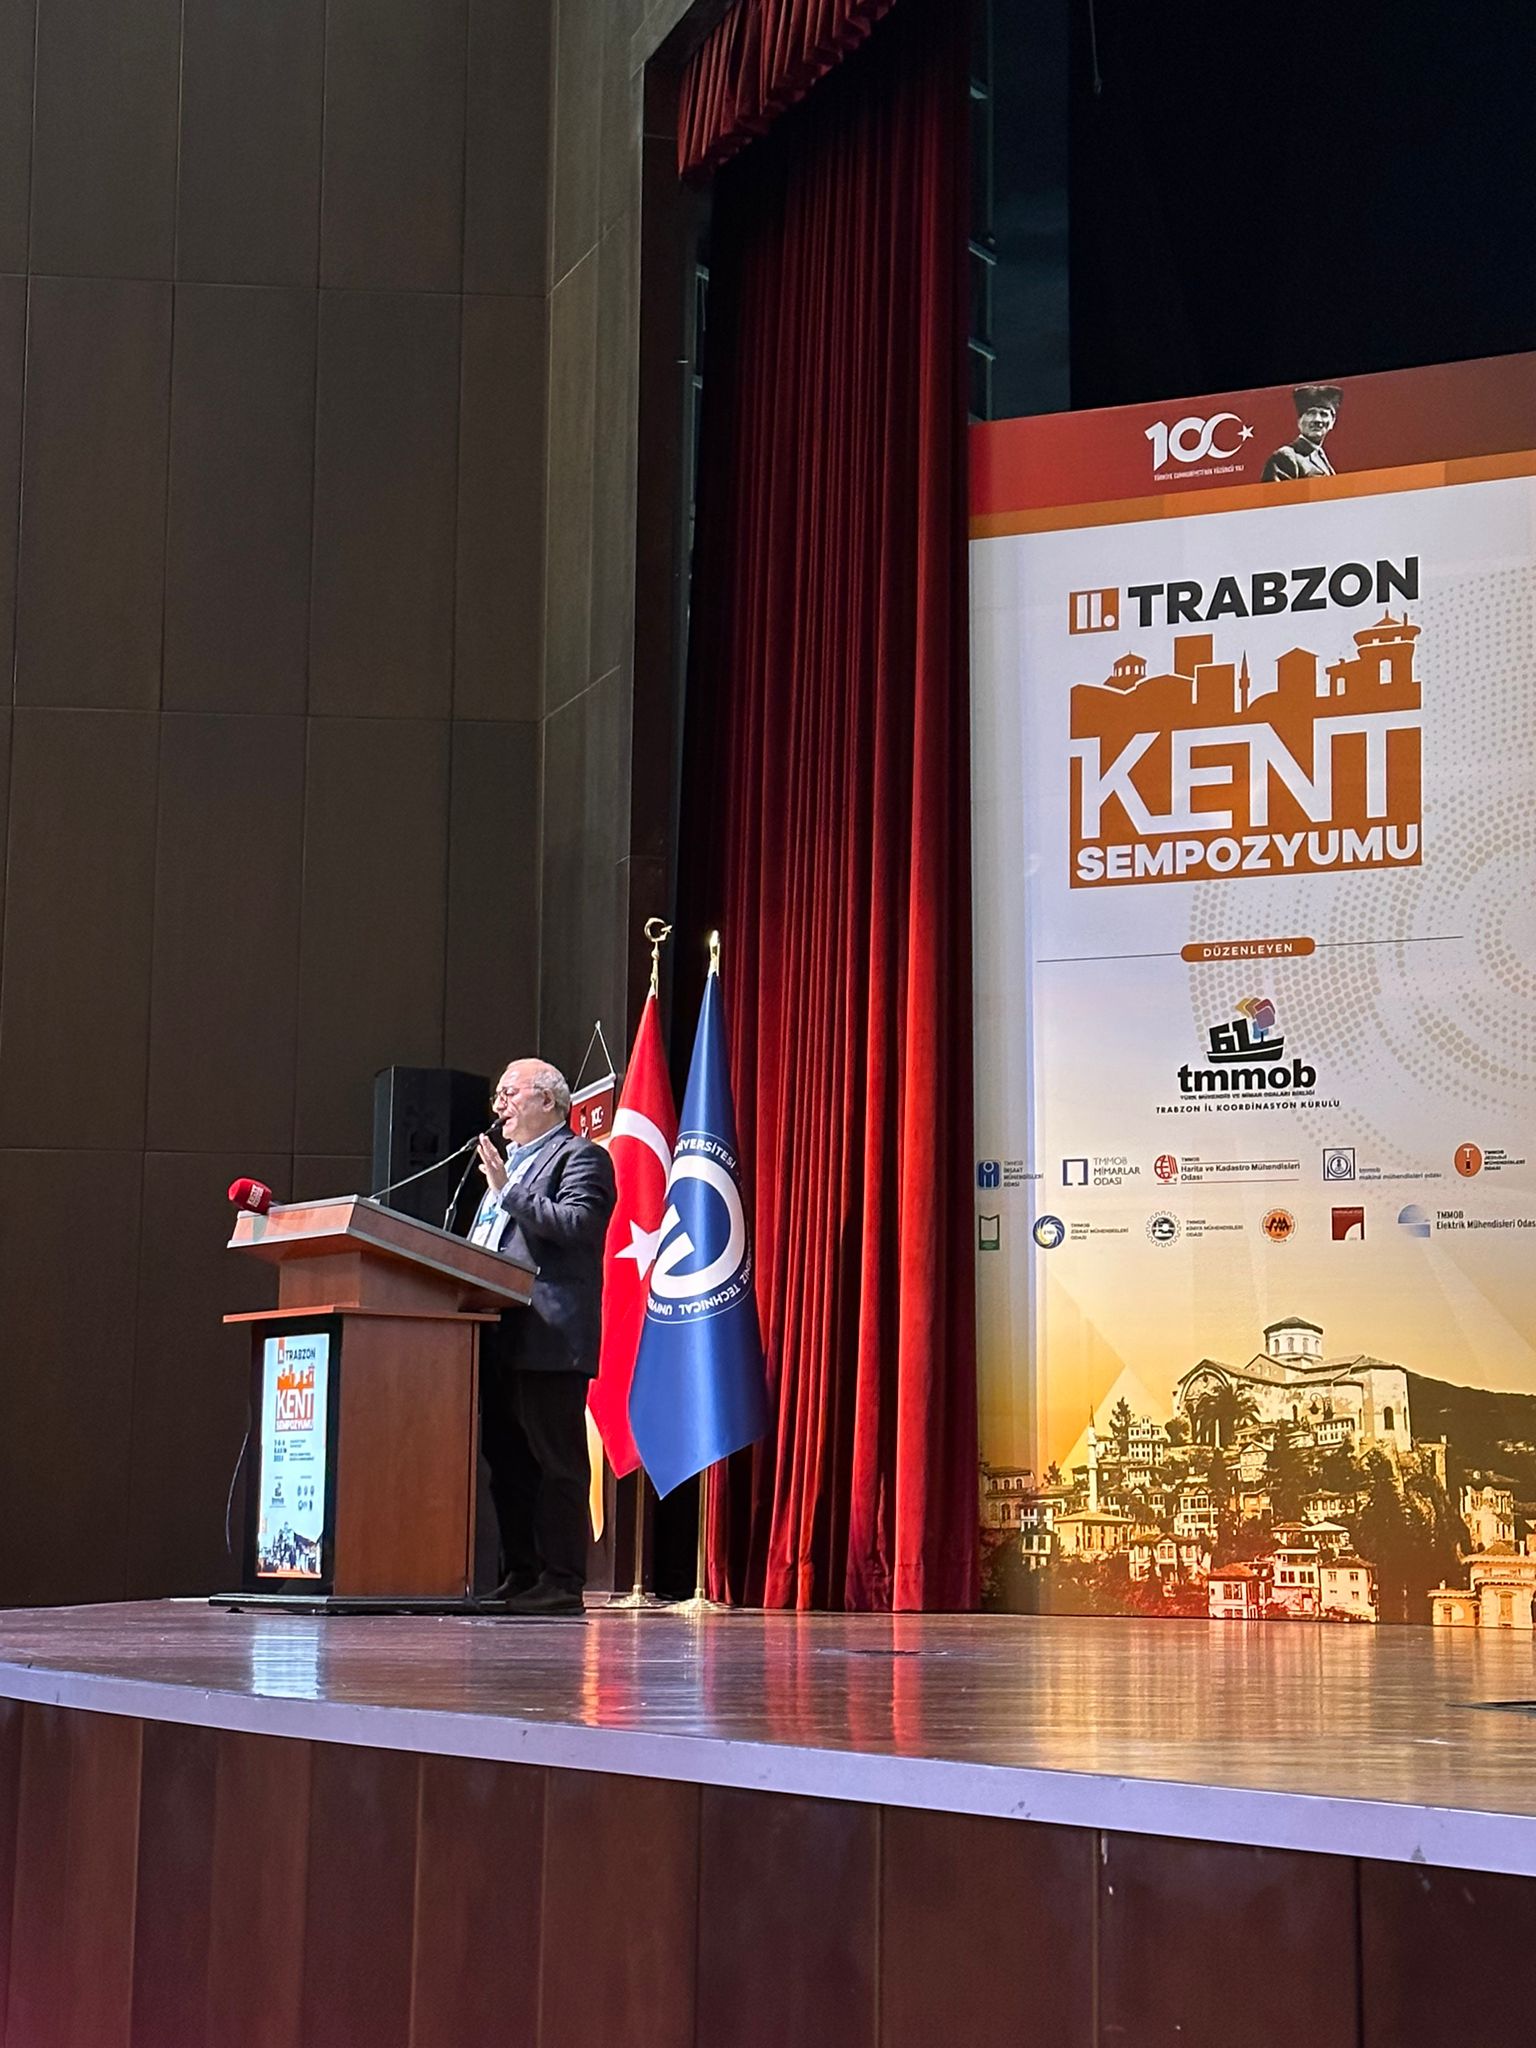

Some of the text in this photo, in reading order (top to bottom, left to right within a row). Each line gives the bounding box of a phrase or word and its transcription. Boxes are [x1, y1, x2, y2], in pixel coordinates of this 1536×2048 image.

[1128, 556, 1420, 628] TRABZON
[1070, 708, 1422, 840] KENT
[1076, 823, 1419, 881] SEMPOZYUMU
[1203, 943, 1293, 957] DÜZENLEYEN
[1177, 1058, 1317, 1093] tmmob
[1156, 1100, 1340, 1114] TRABZON İL KOORDİNASYON KURULU
[1093, 1157, 1128, 1166] TMMOB
[1181, 1164, 1203, 1173] Harita
[1215, 1163, 1250, 1172] Kadastro
[1251, 1161, 1300, 1171] Mühendisleri
[1093, 1165, 1141, 1176] MİMARLAR
[1181, 1173, 1203, 1181] Odası
[1093, 1177, 1122, 1186] ODASI
[1436, 1210, 1464, 1219] TMMOB
[1436, 1218, 1536, 1230] Elektrik Mühendisleri Odas
[678, 1283, 742, 1316] TECHNICAL
[285, 1346, 317, 1361] TRABZON
[276, 1388, 315, 1420] KENT
